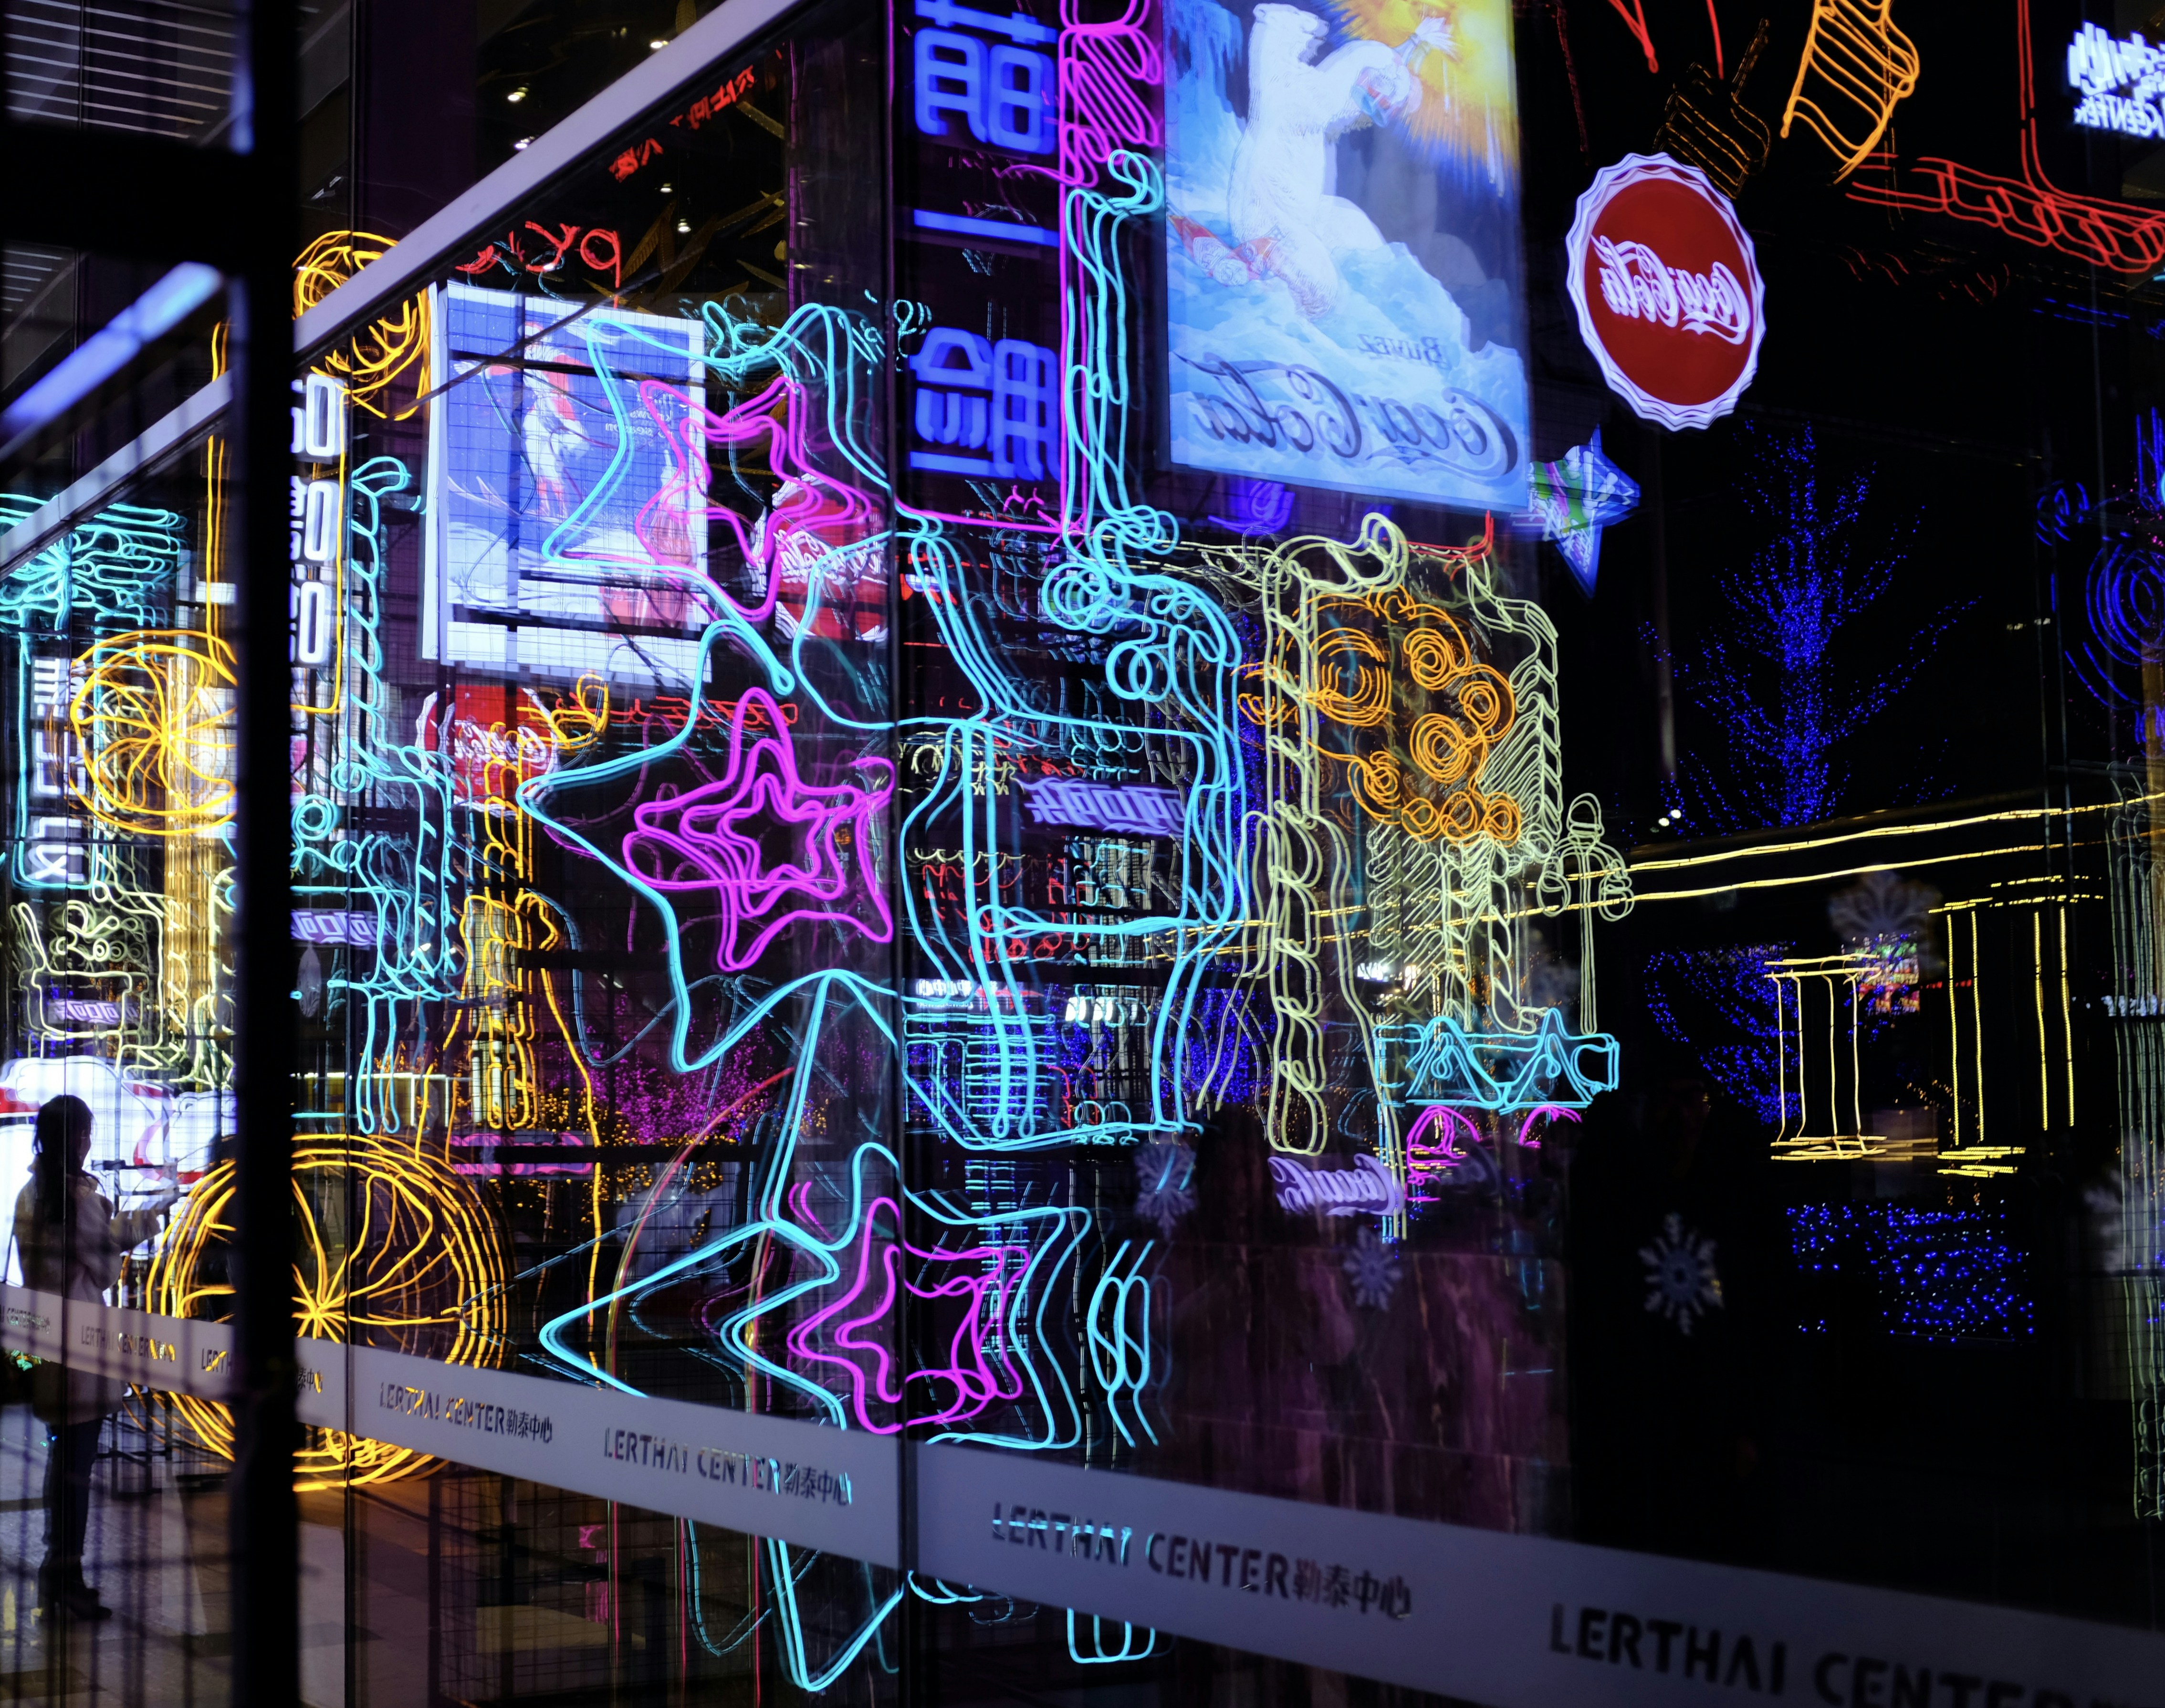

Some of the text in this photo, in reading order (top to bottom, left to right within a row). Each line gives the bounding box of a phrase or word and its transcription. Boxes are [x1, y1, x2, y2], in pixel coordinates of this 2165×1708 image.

[380, 1382, 553, 1444] LERTHAI CENTER 勒泰中心
[604, 1427, 852, 1506] LERTHAI CENTER 勒泰中心
[991, 1501, 1412, 1619] LERTHAI CENTER 勒泰中心
[1550, 1602, 1788, 1697] LERTHAI
